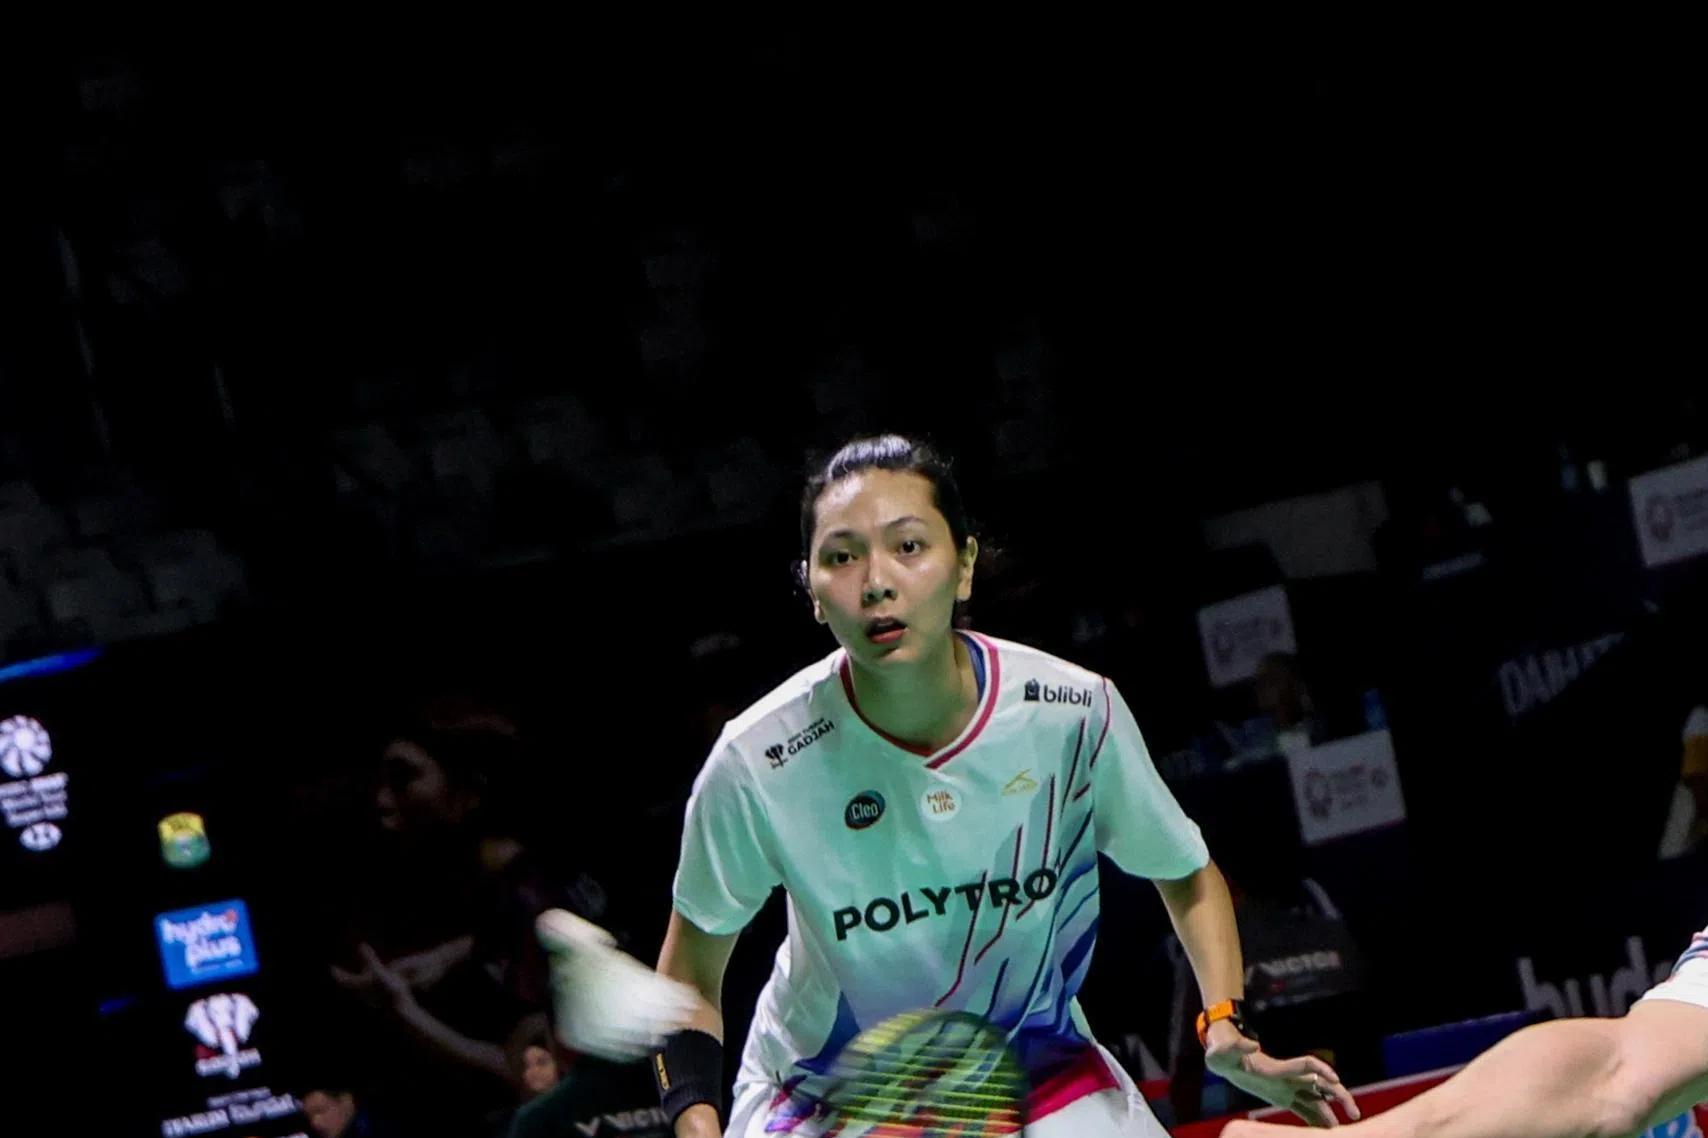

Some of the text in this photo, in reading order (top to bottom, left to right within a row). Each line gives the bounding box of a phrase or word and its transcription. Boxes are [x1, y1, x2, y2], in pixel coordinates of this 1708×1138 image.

[1043, 684, 1093, 708] blibli
[787, 719, 836, 756] GADJAH
[926, 790, 955, 804] Milk
[851, 802, 881, 820] Cleo
[932, 801, 957, 815] Life
[833, 860, 1062, 942] POLYTRO
